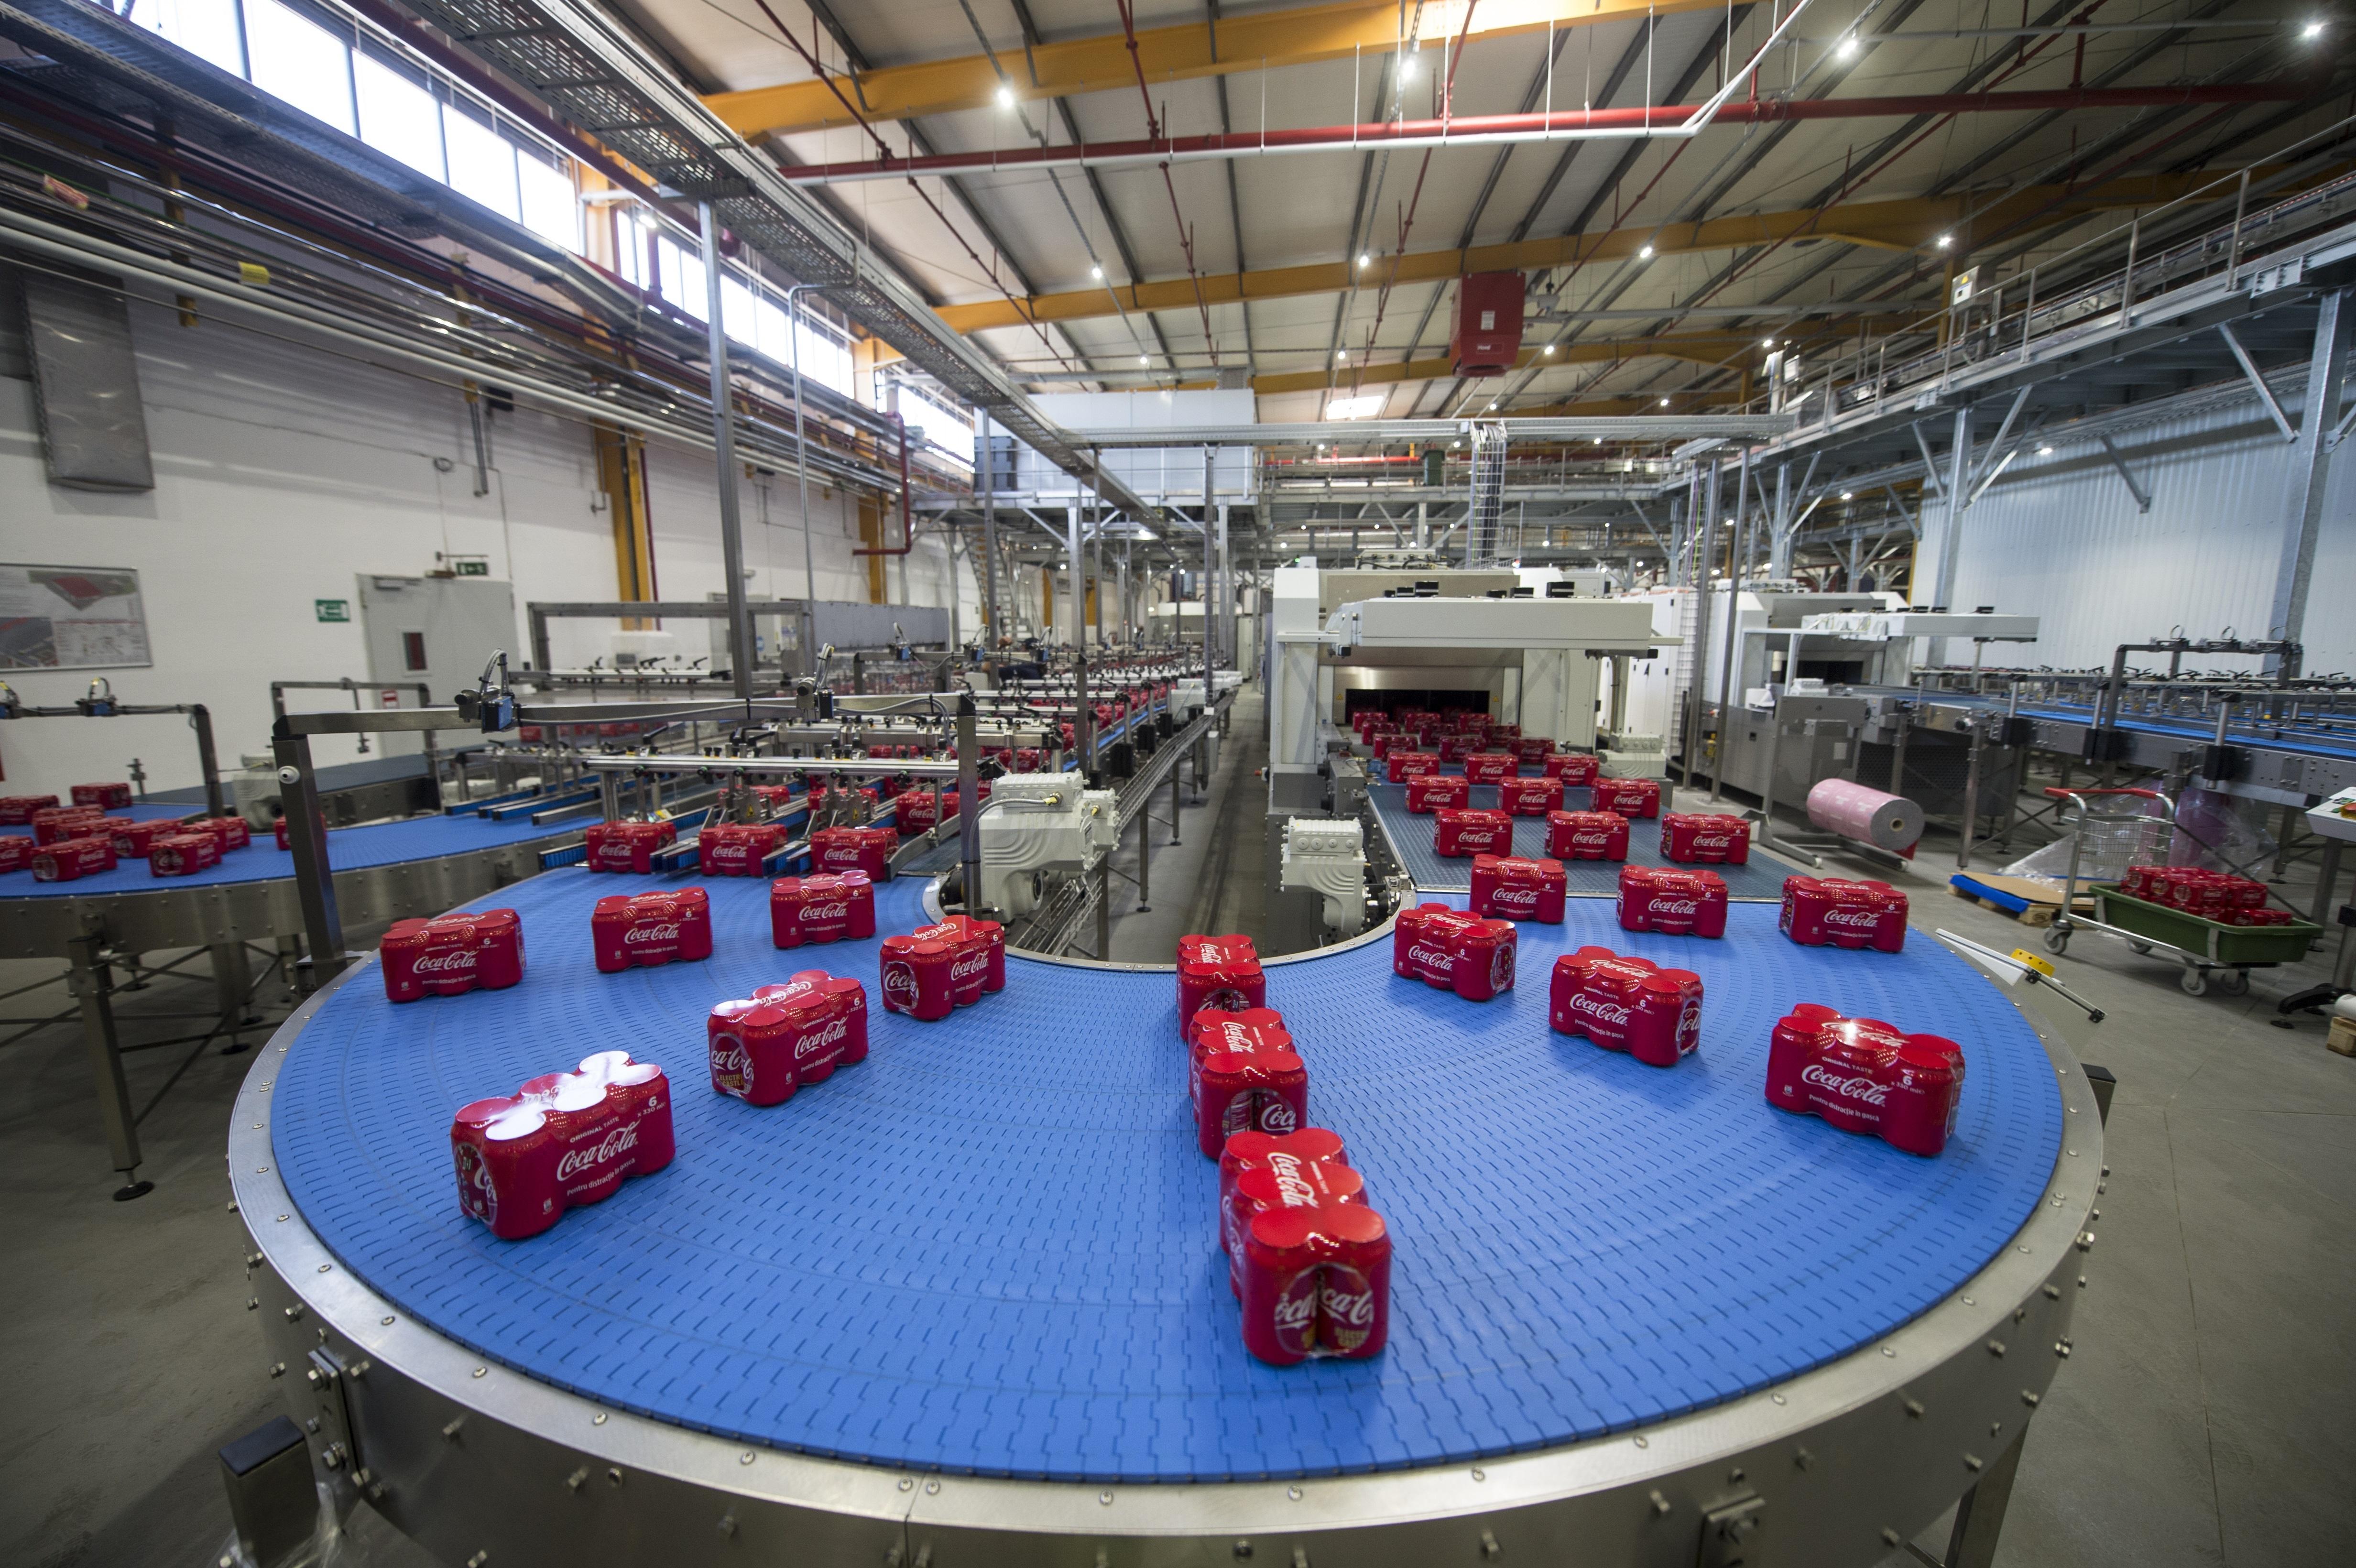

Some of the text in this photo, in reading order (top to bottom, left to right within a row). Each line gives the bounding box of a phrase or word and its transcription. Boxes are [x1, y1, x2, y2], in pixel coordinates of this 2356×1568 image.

[1459, 832, 1494, 843] Coca-Cola
[1572, 833, 1609, 844] Coca-Cola
[1693, 835, 1732, 847] Coca-Cola
[1493, 888, 1540, 904] Coca-Cola
[799, 901, 849, 921] Coca-Cola
[1648, 898, 1700, 915] Coca-Cola
[1824, 910, 1882, 927] Coca-Cola
[624, 923, 681, 944] Coca-Cola
[413, 950, 480, 974] Coca-Cola
[951, 949, 990, 981] Coca-Cola
[1408, 945, 1456, 971] Coca-Cola
[854, 997, 860, 1006] 6
[1570, 993, 1633, 1025] Coca-Cola
[802, 1017, 825, 1029] ORIGINAL
[795, 1015, 849, 1059] Coca-Cola
[1222, 1022, 1255, 1054] Coca-Cola
[1822, 1056, 1873, 1074] ORIGINAL TASTE
[1801, 1065, 1893, 1106] Coca-Cola
[1903, 1076, 1912, 1086] 6
[648, 1096, 657, 1107] 6
[1809, 1094, 1828, 1106] Pentru
[643, 1107, 655, 1115] 330
[569, 1116, 620, 1143] ORIGINAL TASTE
[556, 1119, 641, 1181] Coca-Cola
[1267, 1152, 1320, 1209] Coca-Cola
[567, 1182, 588, 1197] Pentru
